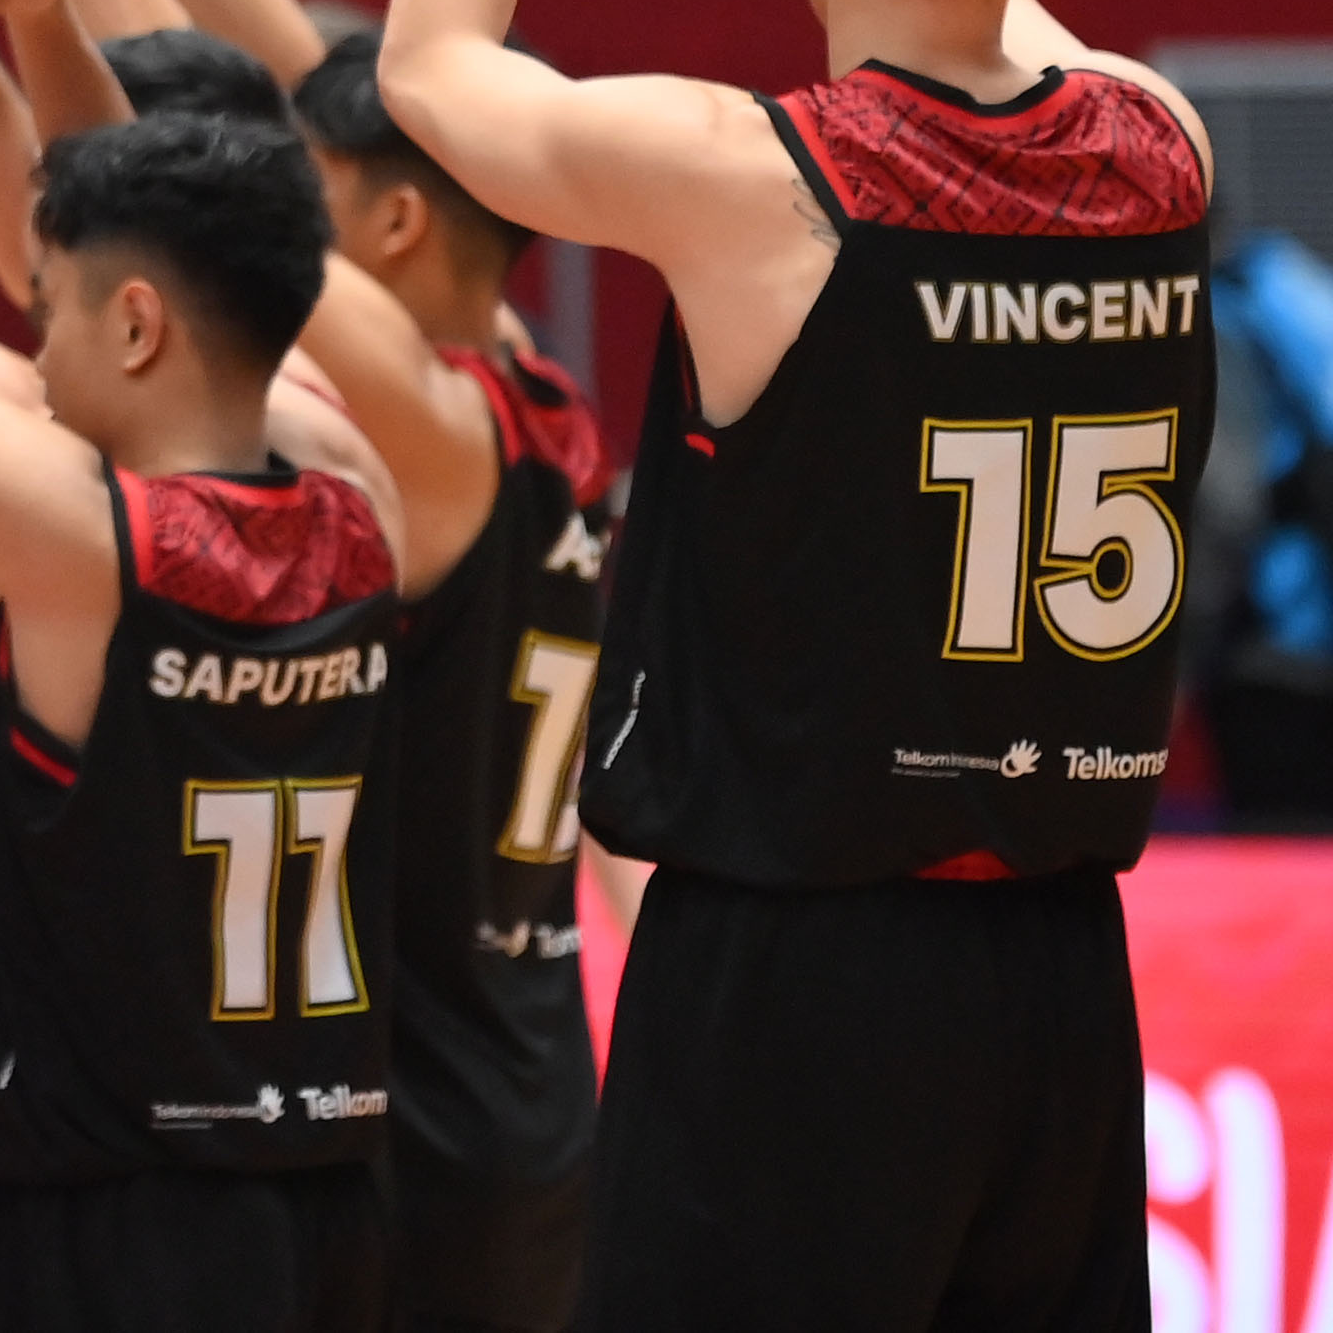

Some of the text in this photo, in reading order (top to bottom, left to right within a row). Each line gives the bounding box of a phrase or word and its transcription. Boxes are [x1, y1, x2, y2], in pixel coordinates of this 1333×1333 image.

[914, 275, 1200, 344] VINCENT
[919, 407, 1185, 663] 15
[148, 642, 389, 708] SAPUTERA
[496, 627, 602, 864] 1
[183, 774, 370, 1021] 11
